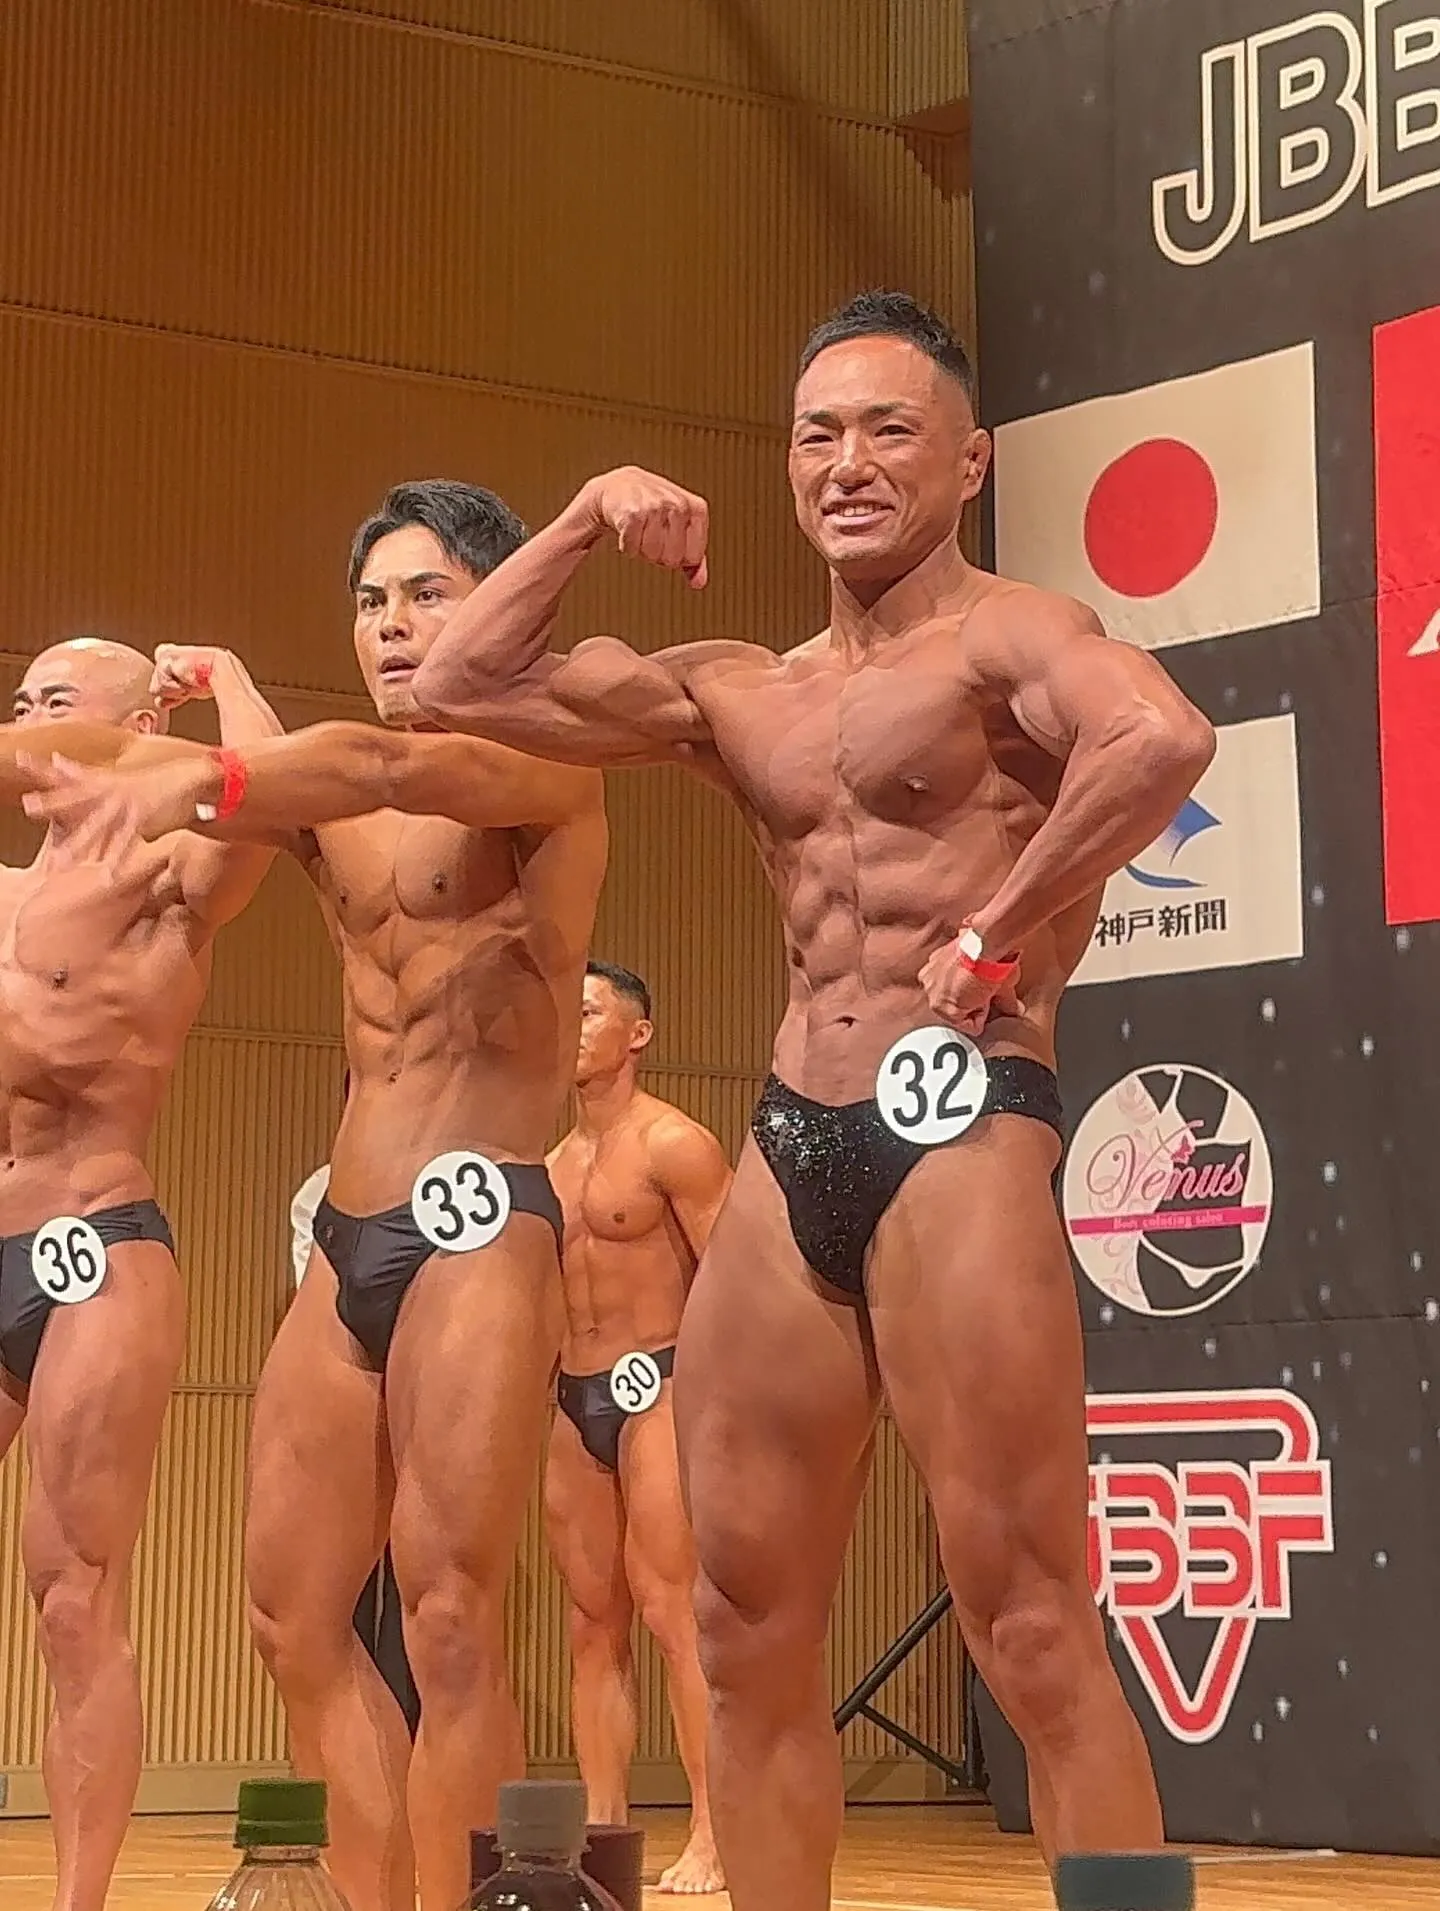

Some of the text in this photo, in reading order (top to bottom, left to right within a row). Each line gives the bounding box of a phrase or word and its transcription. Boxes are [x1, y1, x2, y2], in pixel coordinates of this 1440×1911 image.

[1095, 898, 1227, 948] 神戸新聞
[890, 1041, 973, 1128] 32
[421, 1161, 500, 1241] 33
[1086, 1119, 1246, 1210] Venus
[38, 1227, 98, 1293] 36
[615, 1357, 656, 1407] 30
